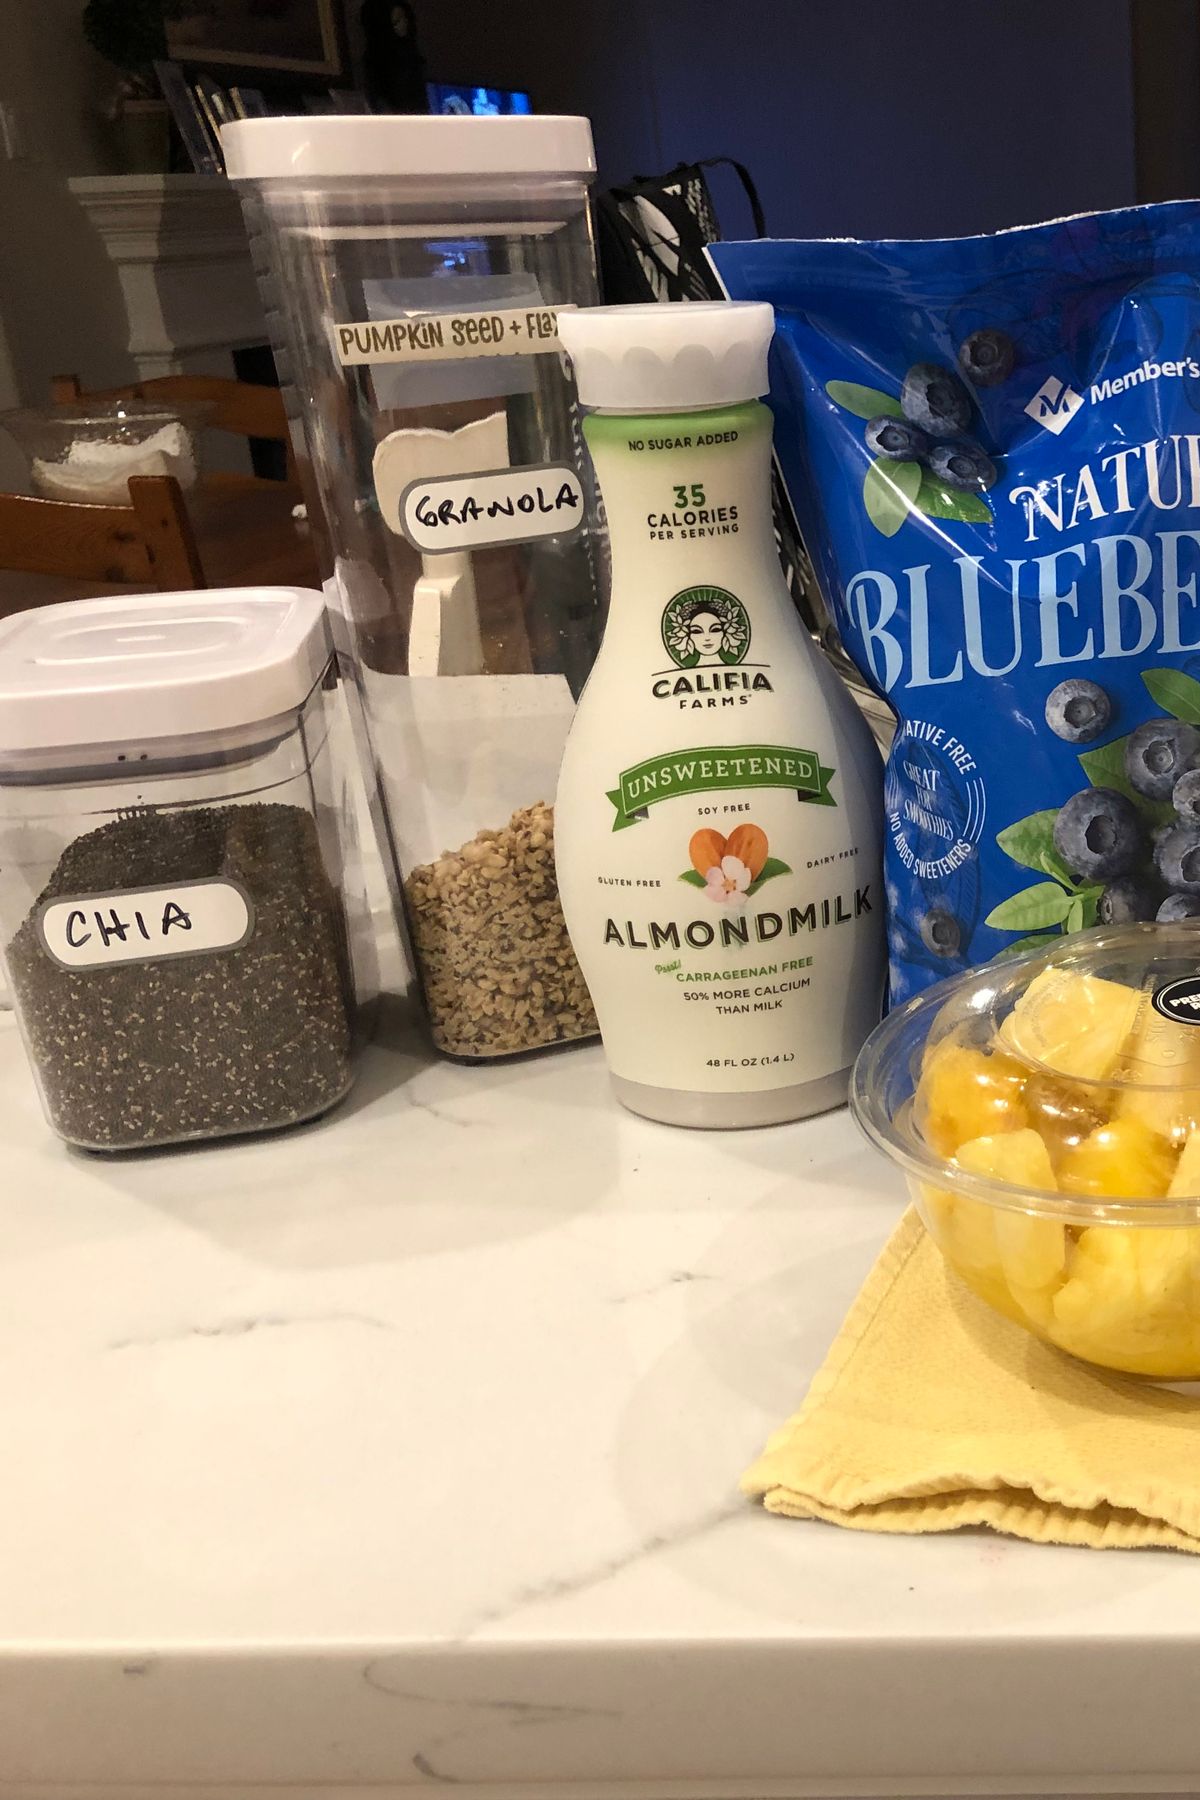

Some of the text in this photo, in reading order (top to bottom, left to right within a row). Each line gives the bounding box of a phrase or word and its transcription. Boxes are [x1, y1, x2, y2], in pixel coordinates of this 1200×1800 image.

[509, 320, 522, 335] +
[1090, 356, 1200, 406] Member's
[628, 430, 739, 451] NO SUGAR ADDED
[414, 483, 579, 528] GRANOLA
[673, 483, 706, 509] 35
[647, 505, 738, 528] CALORIES
[650, 523, 739, 540] PER SERVING
[652, 672, 775, 699] CALIFIA
[679, 695, 750, 710] FARMS
[942, 737, 977, 775] FREE
[627, 757, 813, 799] UNSWEETENED
[697, 803, 751, 816] SOY FREE
[889, 811, 971, 880] NO ADDED SWEETENERS
[806, 847, 860, 869] DAIRY FREE
[597, 876, 662, 888] GLUTEN FREE
[65, 902, 193, 948] CHIA
[603, 884, 874, 950] ALMONDMILK
[676, 964, 778, 983] CARRAGEENAN
[781, 956, 813, 972] FREE
[683, 977, 811, 1001] 50% MORE CALCIUM
[716, 999, 783, 1015] THAN MILK
[706, 1053, 795, 1067] 48 FL OZ (1.4 L)
